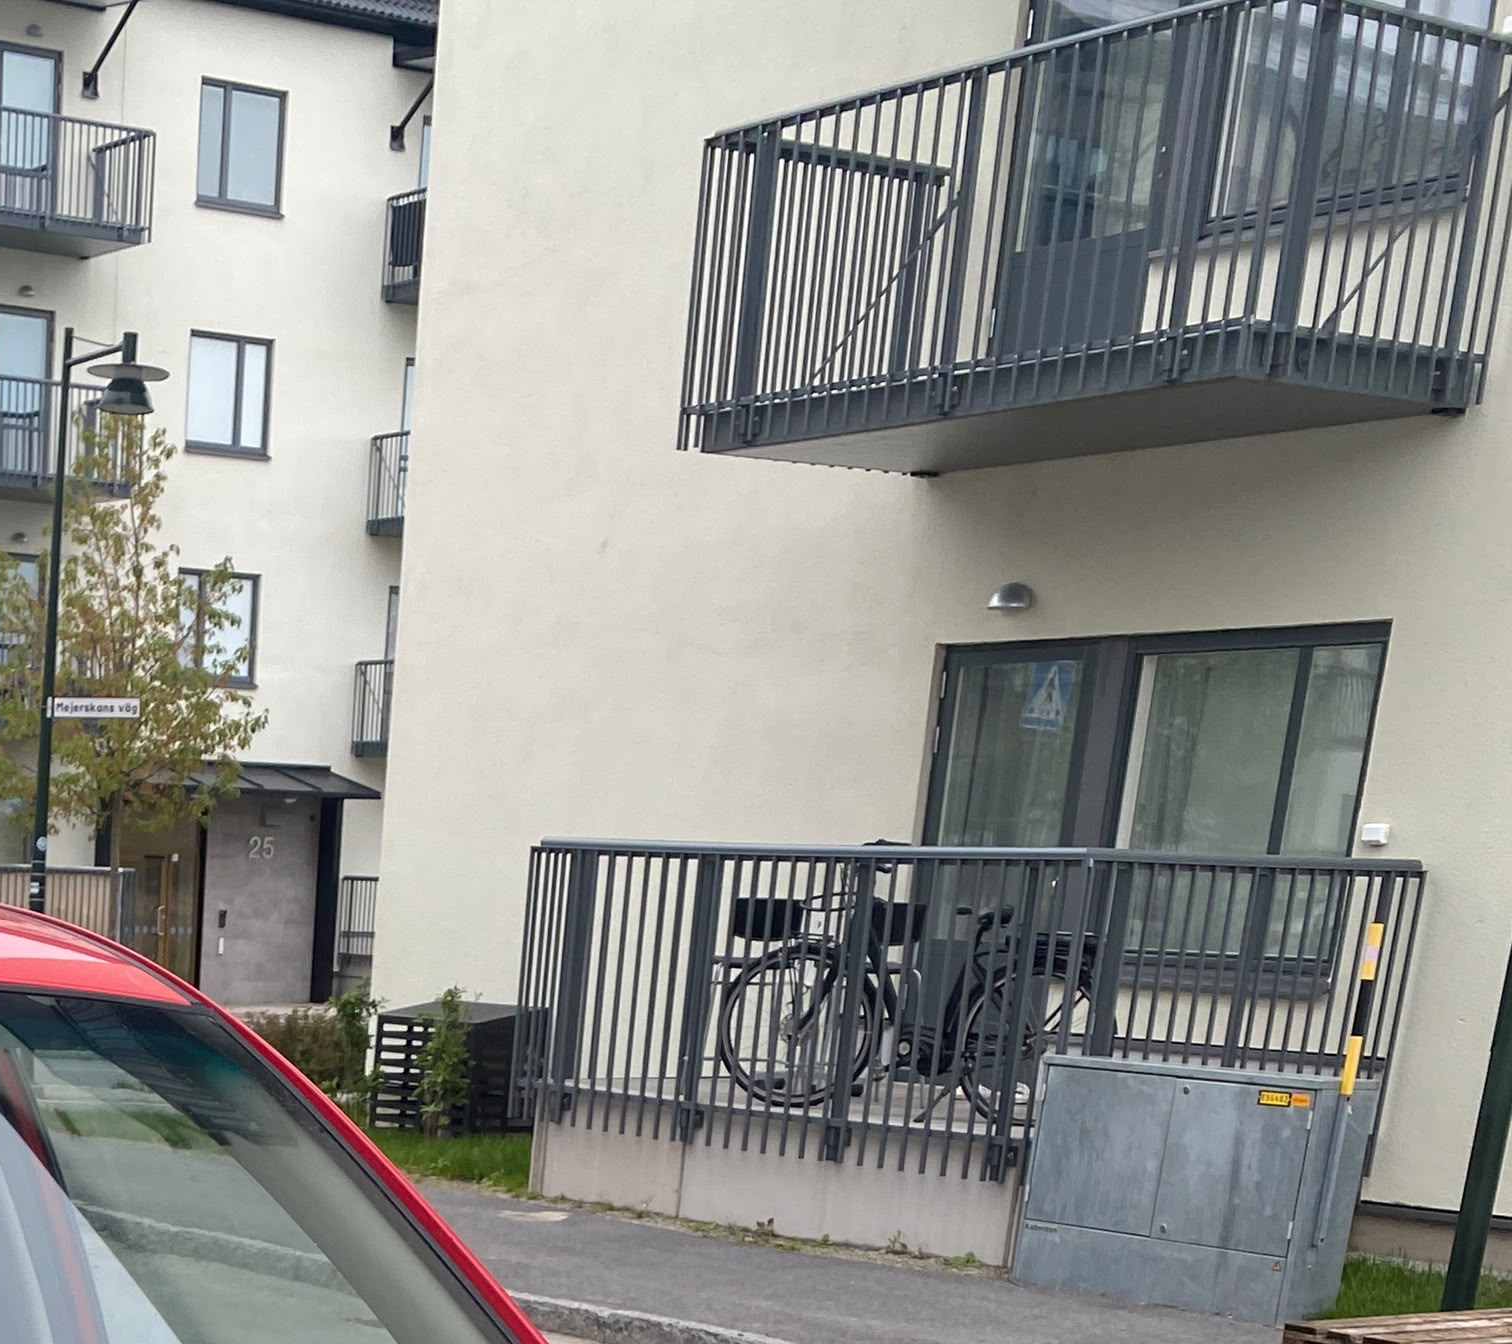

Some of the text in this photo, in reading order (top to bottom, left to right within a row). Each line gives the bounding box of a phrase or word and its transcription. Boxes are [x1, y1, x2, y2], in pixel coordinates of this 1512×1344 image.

[56, 702, 138, 715] Mejerskans väg
[248, 836, 275, 859] 25
